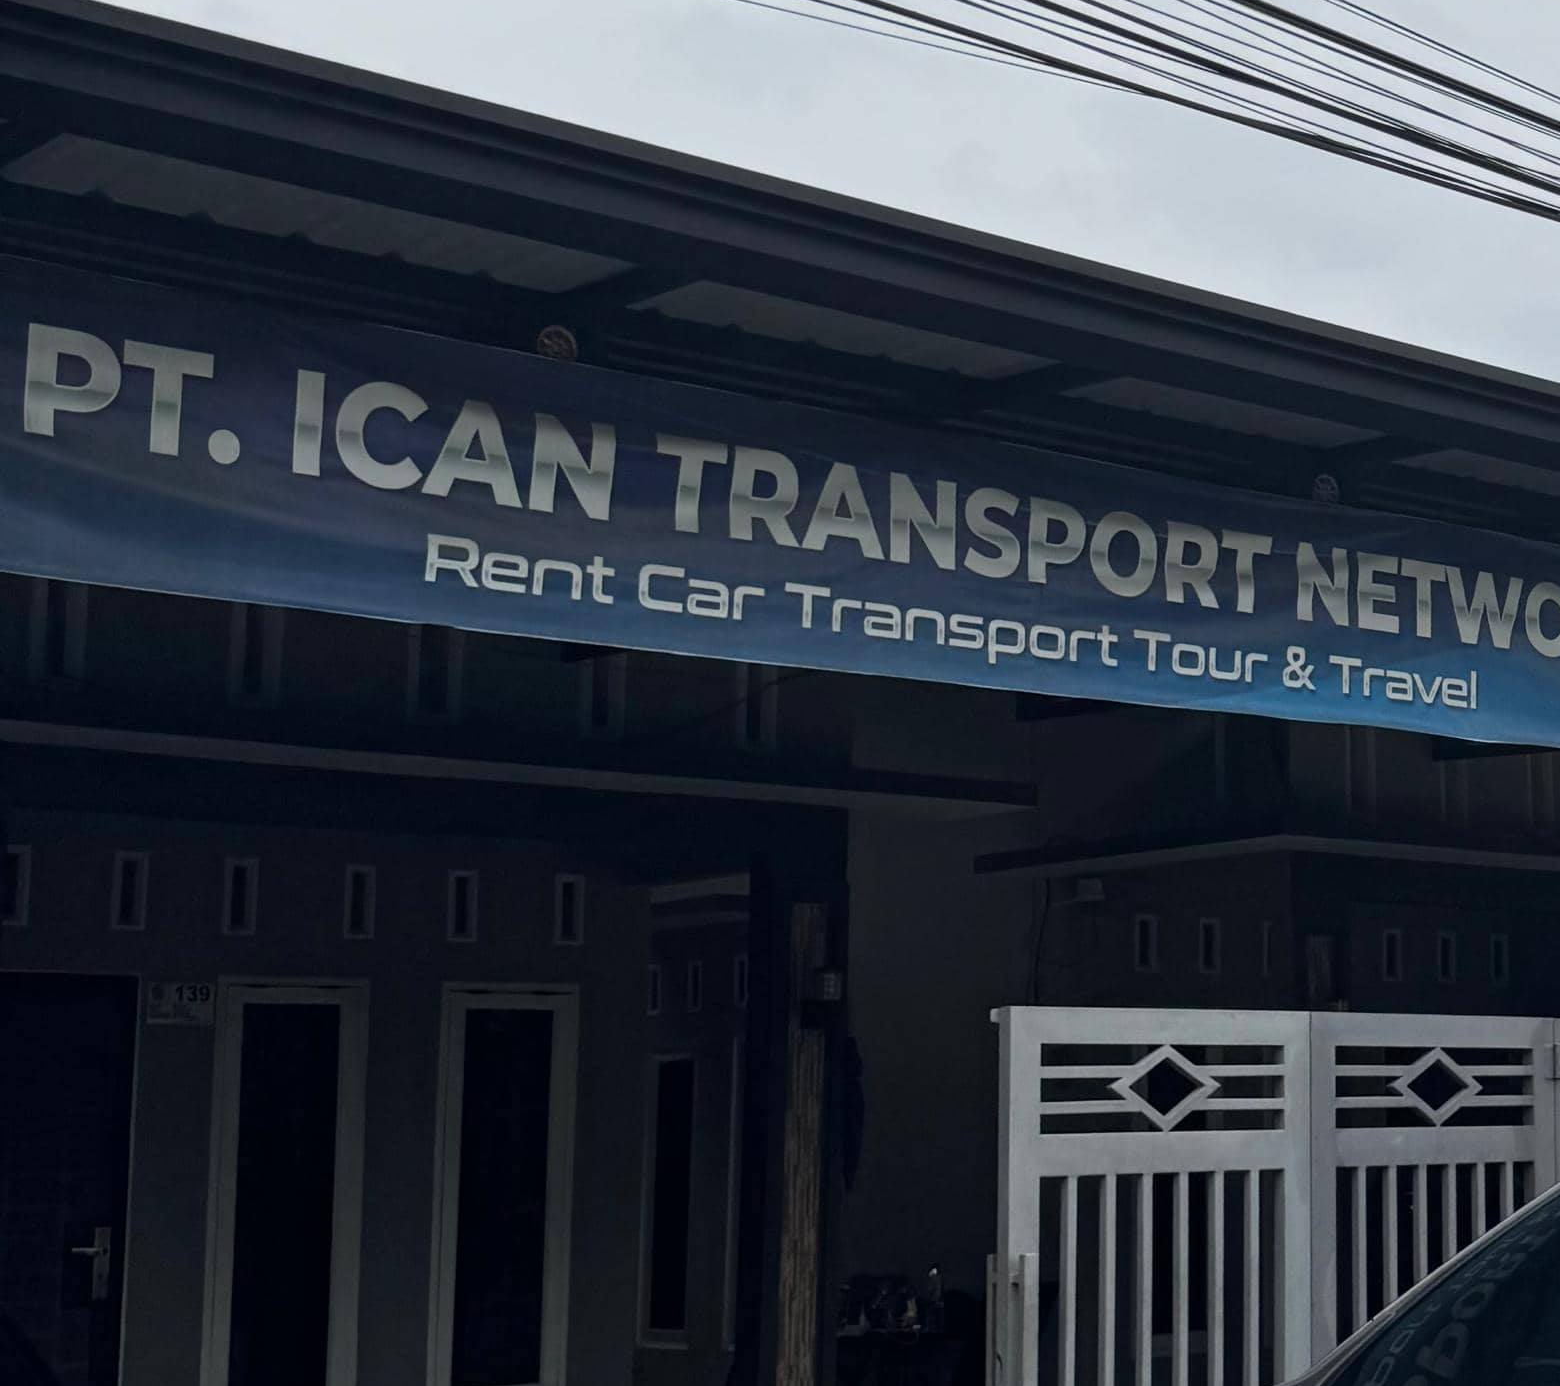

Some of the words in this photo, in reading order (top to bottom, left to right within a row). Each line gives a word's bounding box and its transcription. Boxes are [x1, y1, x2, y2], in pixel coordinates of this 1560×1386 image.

[23, 322, 241, 465] PT.
[292, 370, 617, 521] ICAN
[655, 433, 1272, 614] TRANSPORT
[424, 534, 614, 605] Rent
[638, 564, 764, 621] Car
[785, 582, 1119, 665] Transport
[1134, 628, 1268, 683] Tour
[1282, 645, 1316, 690] &
[1329, 656, 1478, 710] Travel
[175, 985, 210, 1002] 139
